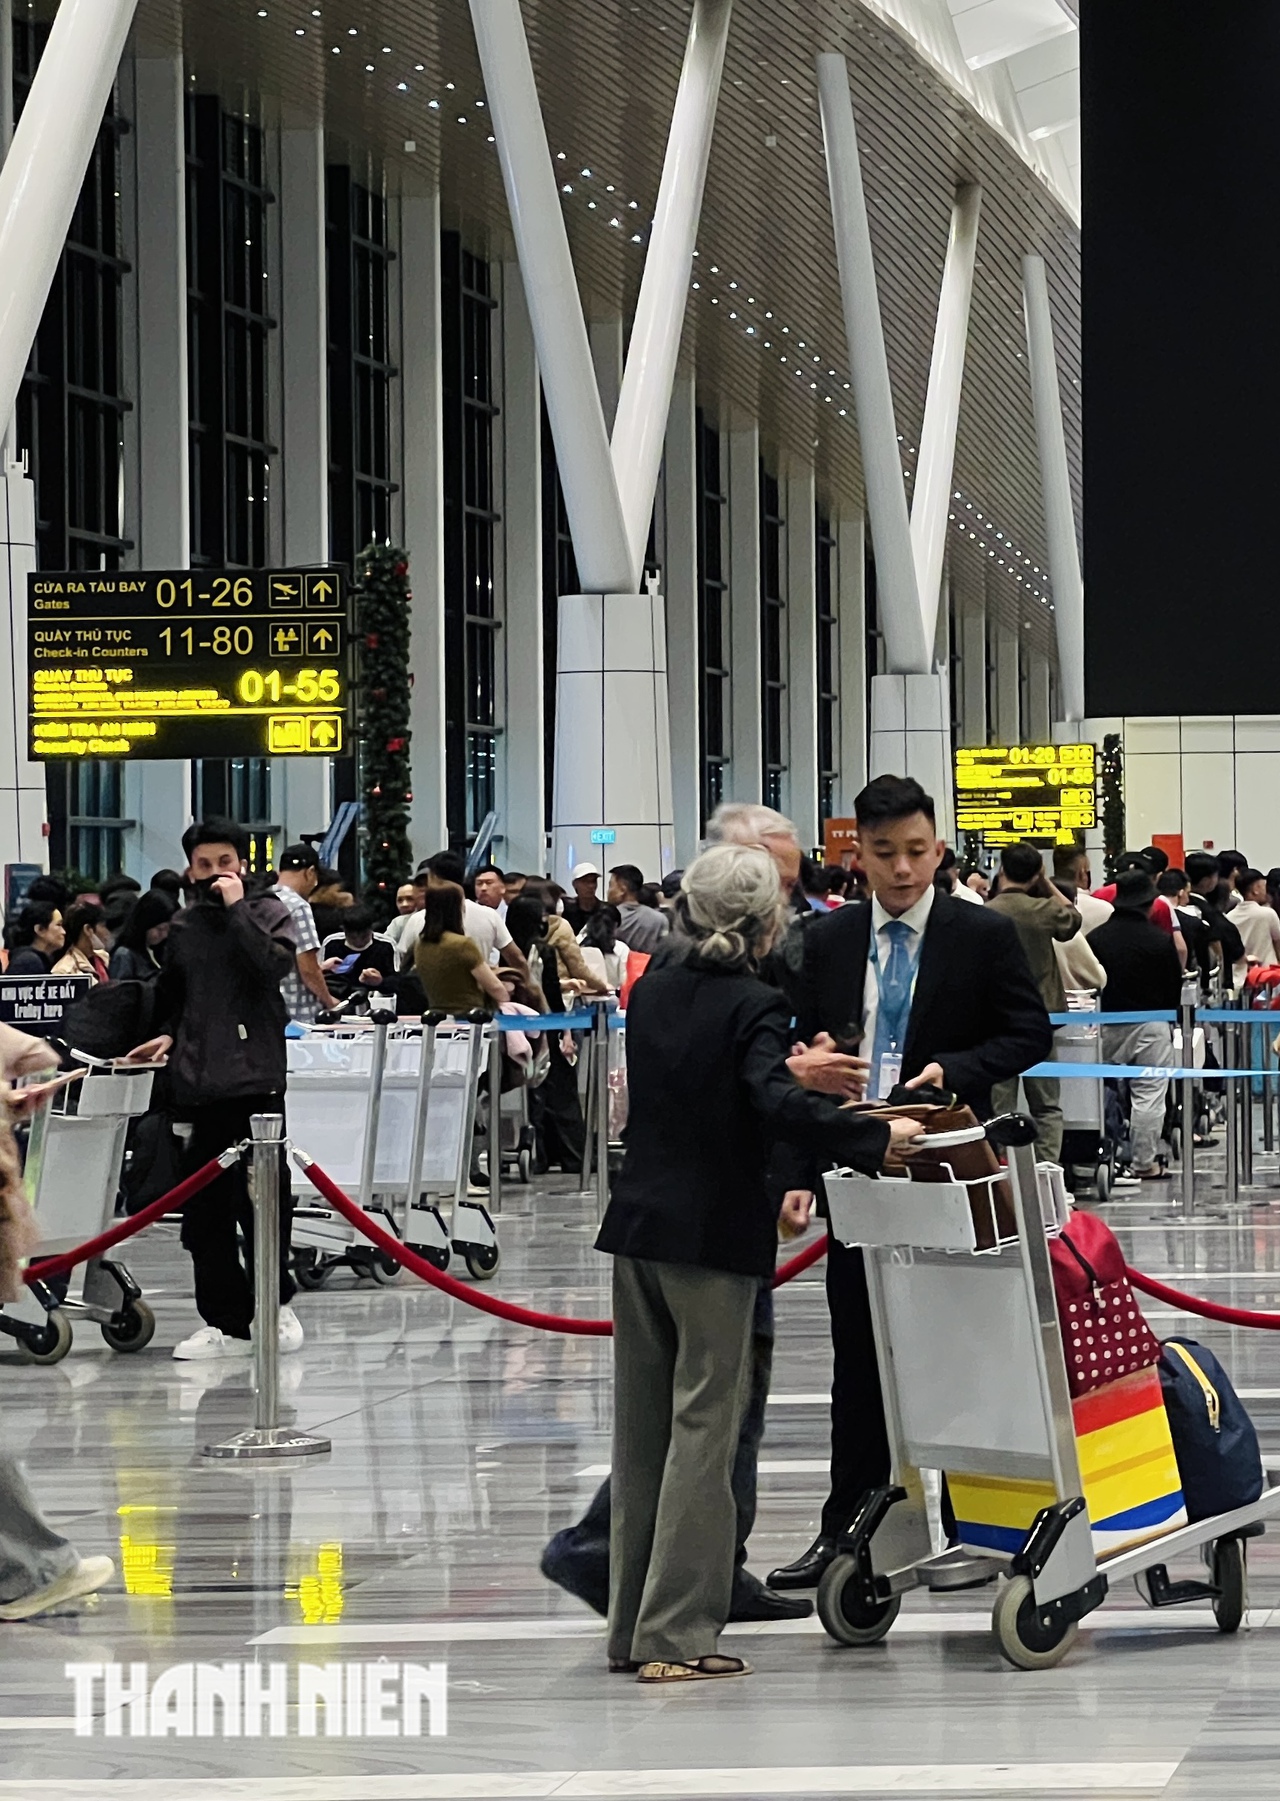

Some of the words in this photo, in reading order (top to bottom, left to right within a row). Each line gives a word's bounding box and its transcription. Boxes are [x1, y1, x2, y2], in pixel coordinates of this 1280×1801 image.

[67, 582, 86, 593] RA
[89, 580, 116, 592] TÀU
[119, 581, 146, 592] BAY
[156, 577, 253, 608] 01-26
[34, 599, 70, 609] Gates
[105, 630, 132, 643] TỤC
[159, 626, 253, 655] 11-80
[34, 647, 88, 658] Check-in
[92, 647, 148, 657] Counters
[239, 669, 340, 702] 01-55
[47, 985, 58, 999] XE
[43, 1002, 63, 1018] here
[1140, 1066, 1179, 1078] ACV
